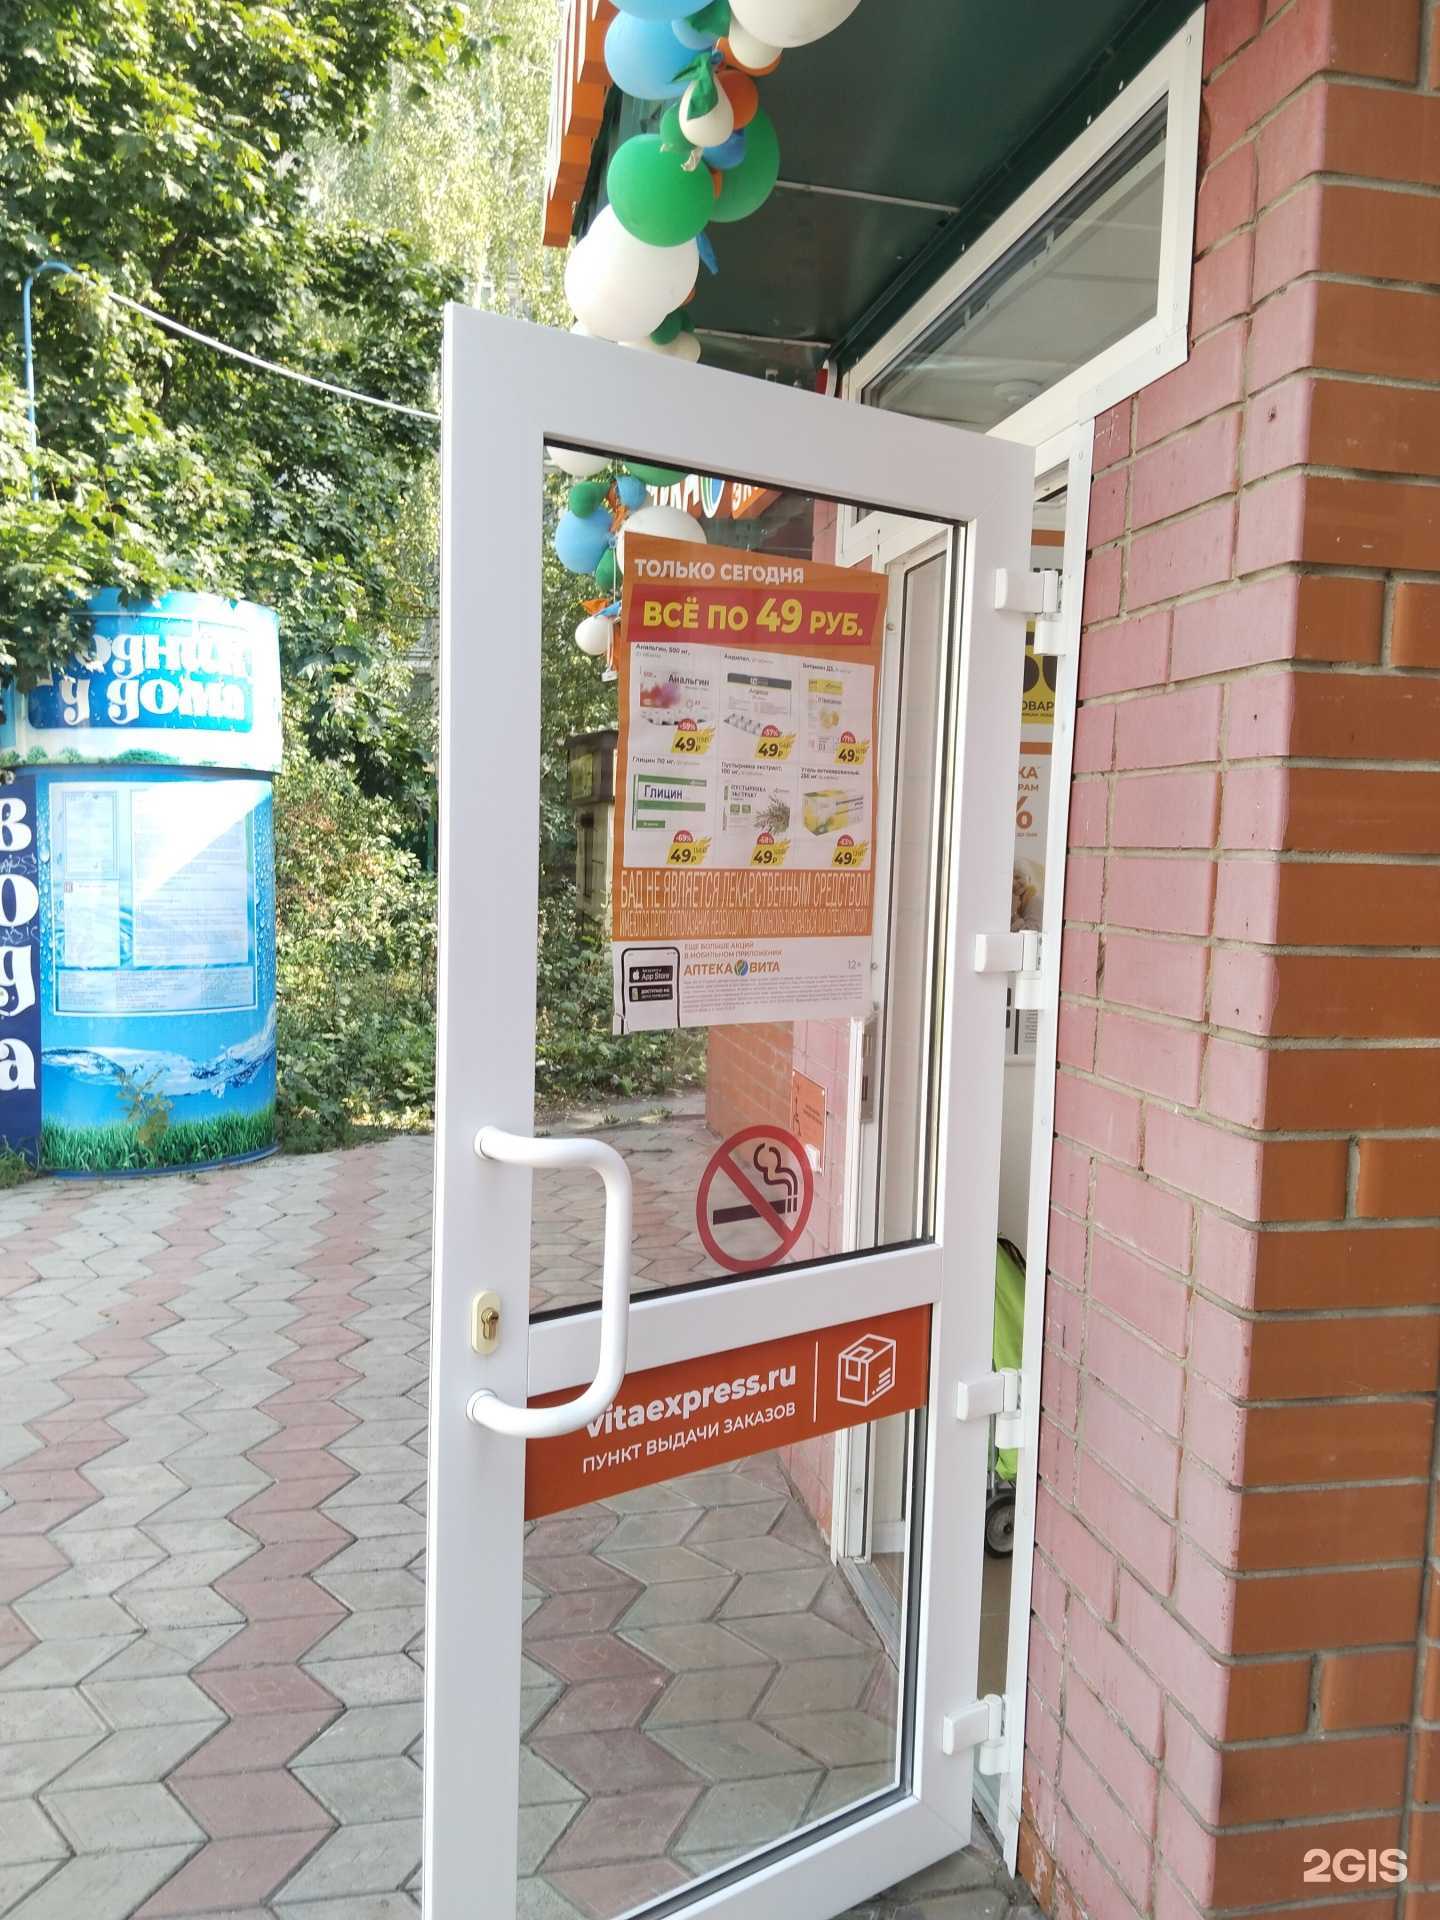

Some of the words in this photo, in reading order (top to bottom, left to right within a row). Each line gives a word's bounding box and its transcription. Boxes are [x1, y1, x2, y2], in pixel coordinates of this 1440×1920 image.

[634, 558, 715, 579] ТОЛЬКО
[719, 562, 805, 585] СЕГОДНЯ
[643, 596, 699, 629] ВСЁ
[707, 604, 749, 631] ПО
[756, 597, 803, 634] 49
[809, 610, 864, 637] РУБ.
[668, 674, 711, 687] Анальгин
[644, 784, 683, 800] Глицин
[621, 870, 643, 910] БАД
[646, 871, 661, 909] НЕ
[663, 871, 720, 909] ЯВЛЯЕТСЯ
[722, 871, 811, 909] ЛЕКАРСТВЕННЫМ
[813, 872, 871, 908] СРЕДСТВОМ
[684, 962, 733, 977] АПТЕКА
[750, 960, 781, 974] ВИТА
[586, 1364, 796, 1439] vitaexpress.ru
[582, 1443, 642, 1474] ПУНКТ
[646, 1424, 720, 1456] ВЫДАЧИ
[723, 1402, 796, 1434] ЗАКАЗОВ
